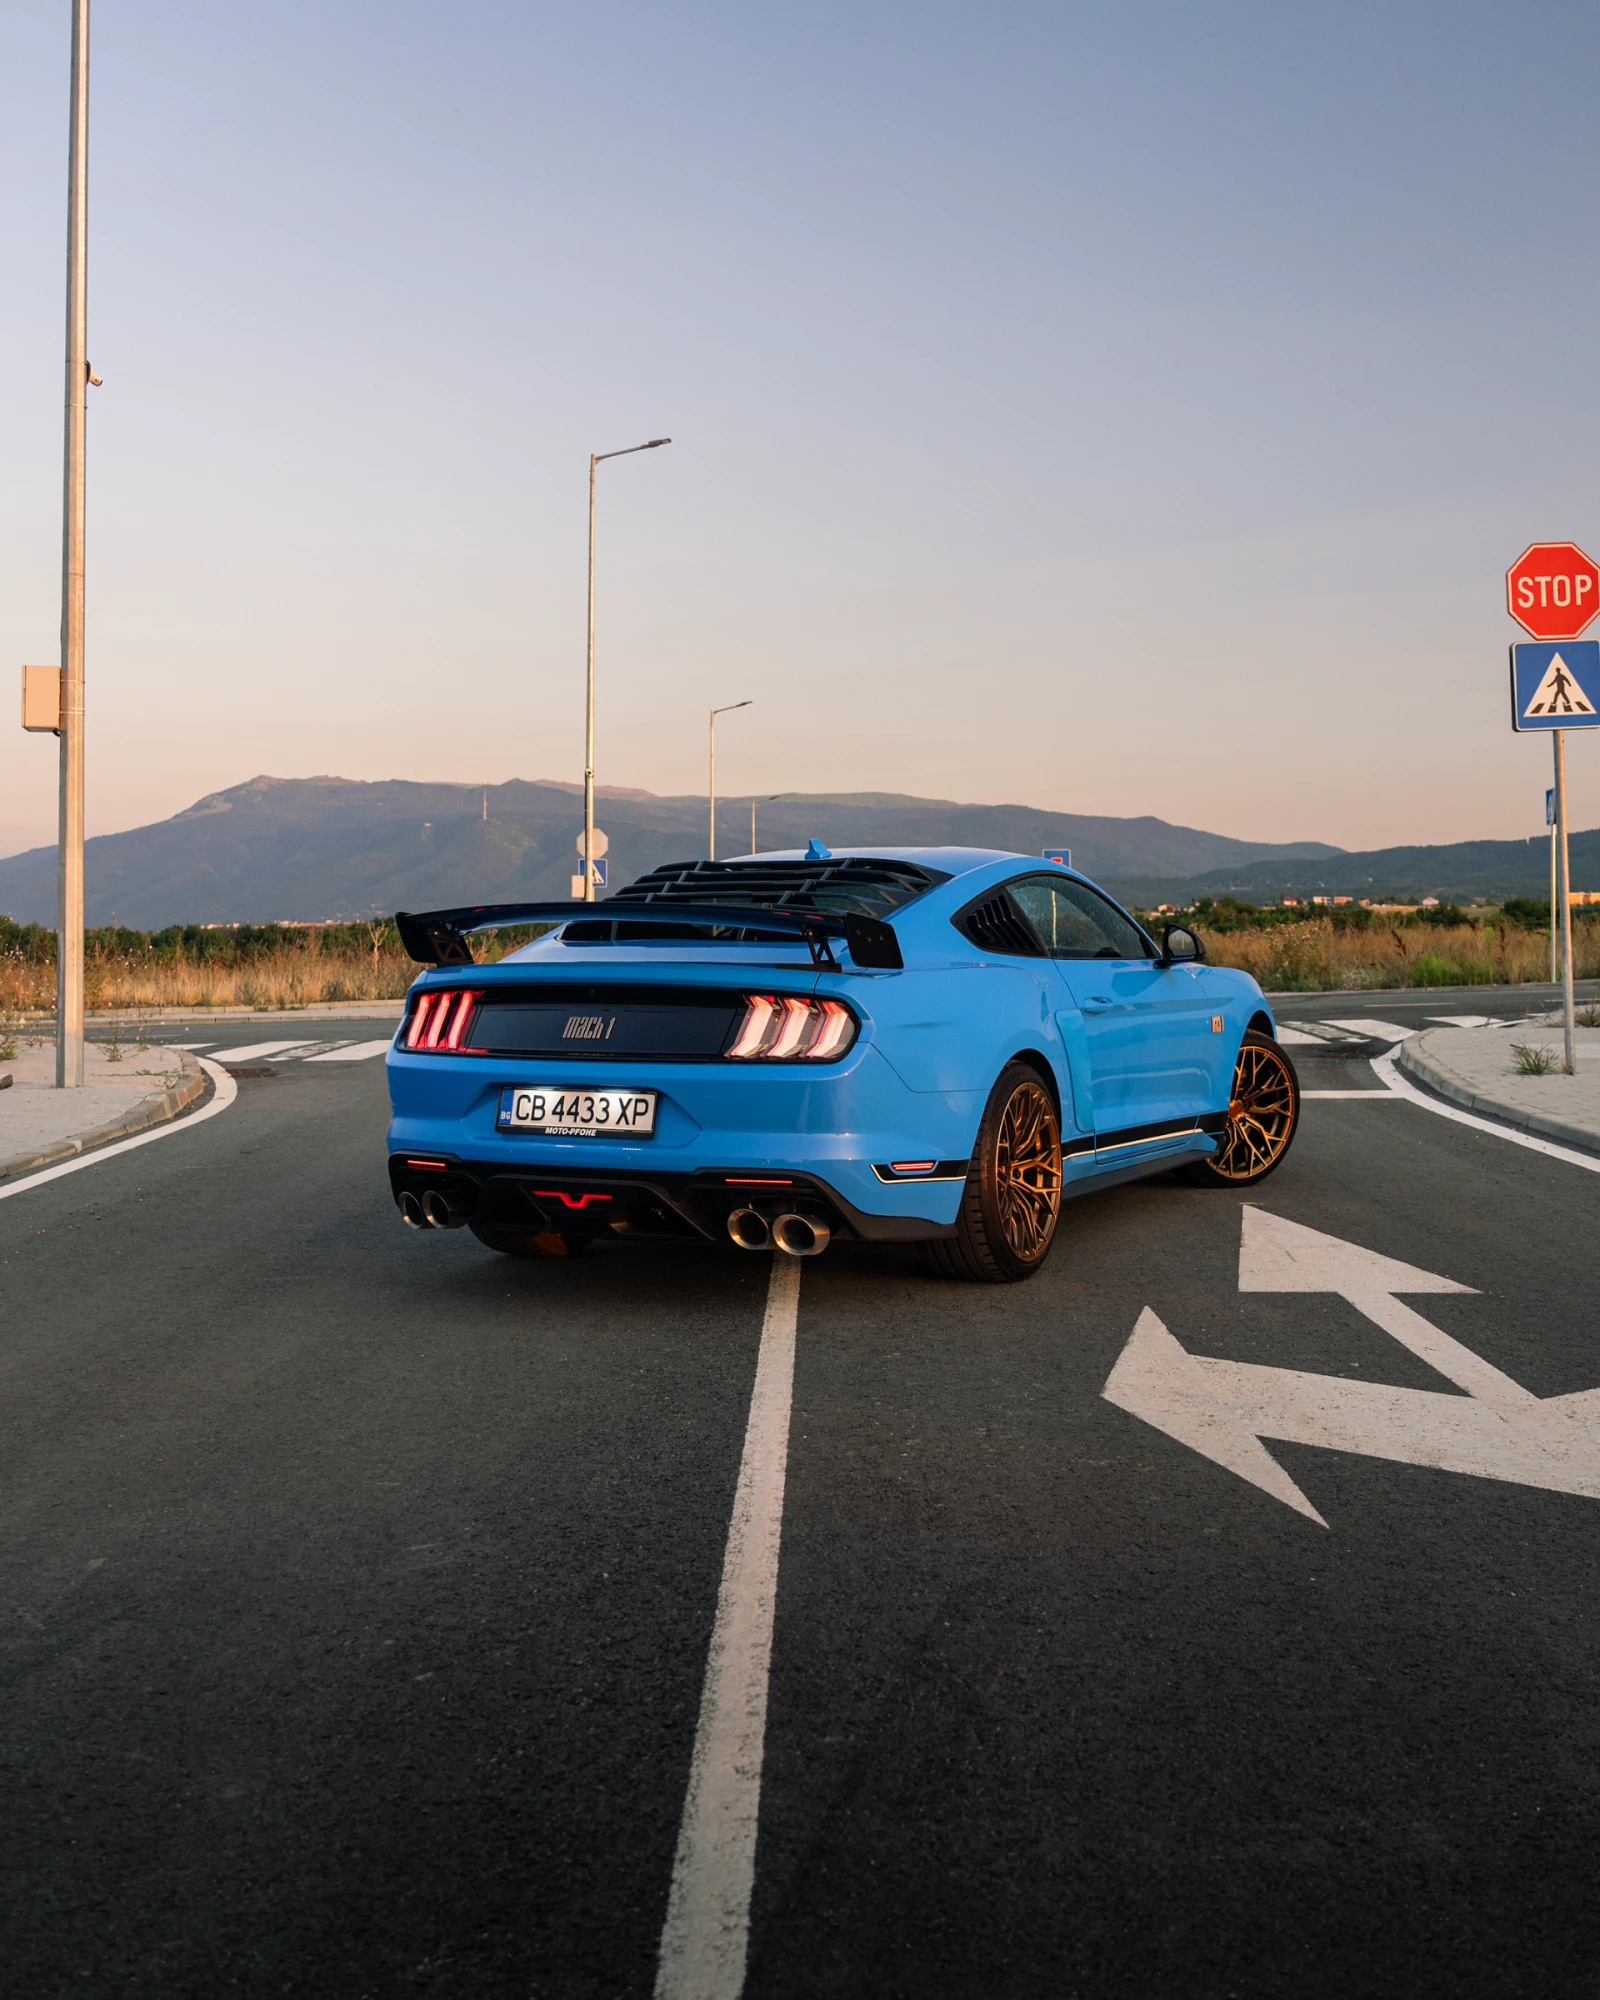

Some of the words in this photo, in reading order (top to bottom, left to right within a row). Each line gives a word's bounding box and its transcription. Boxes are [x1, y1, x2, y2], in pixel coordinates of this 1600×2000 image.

[1517, 574, 1593, 609] STOP
[605, 1017, 616, 1040] 1
[500, 1111, 511, 1120] BG
[515, 1094, 546, 1121] CB
[551, 1095, 610, 1123] 4433
[615, 1098, 649, 1126] XP
[544, 1126, 597, 1137] MOTO-PFOHE
